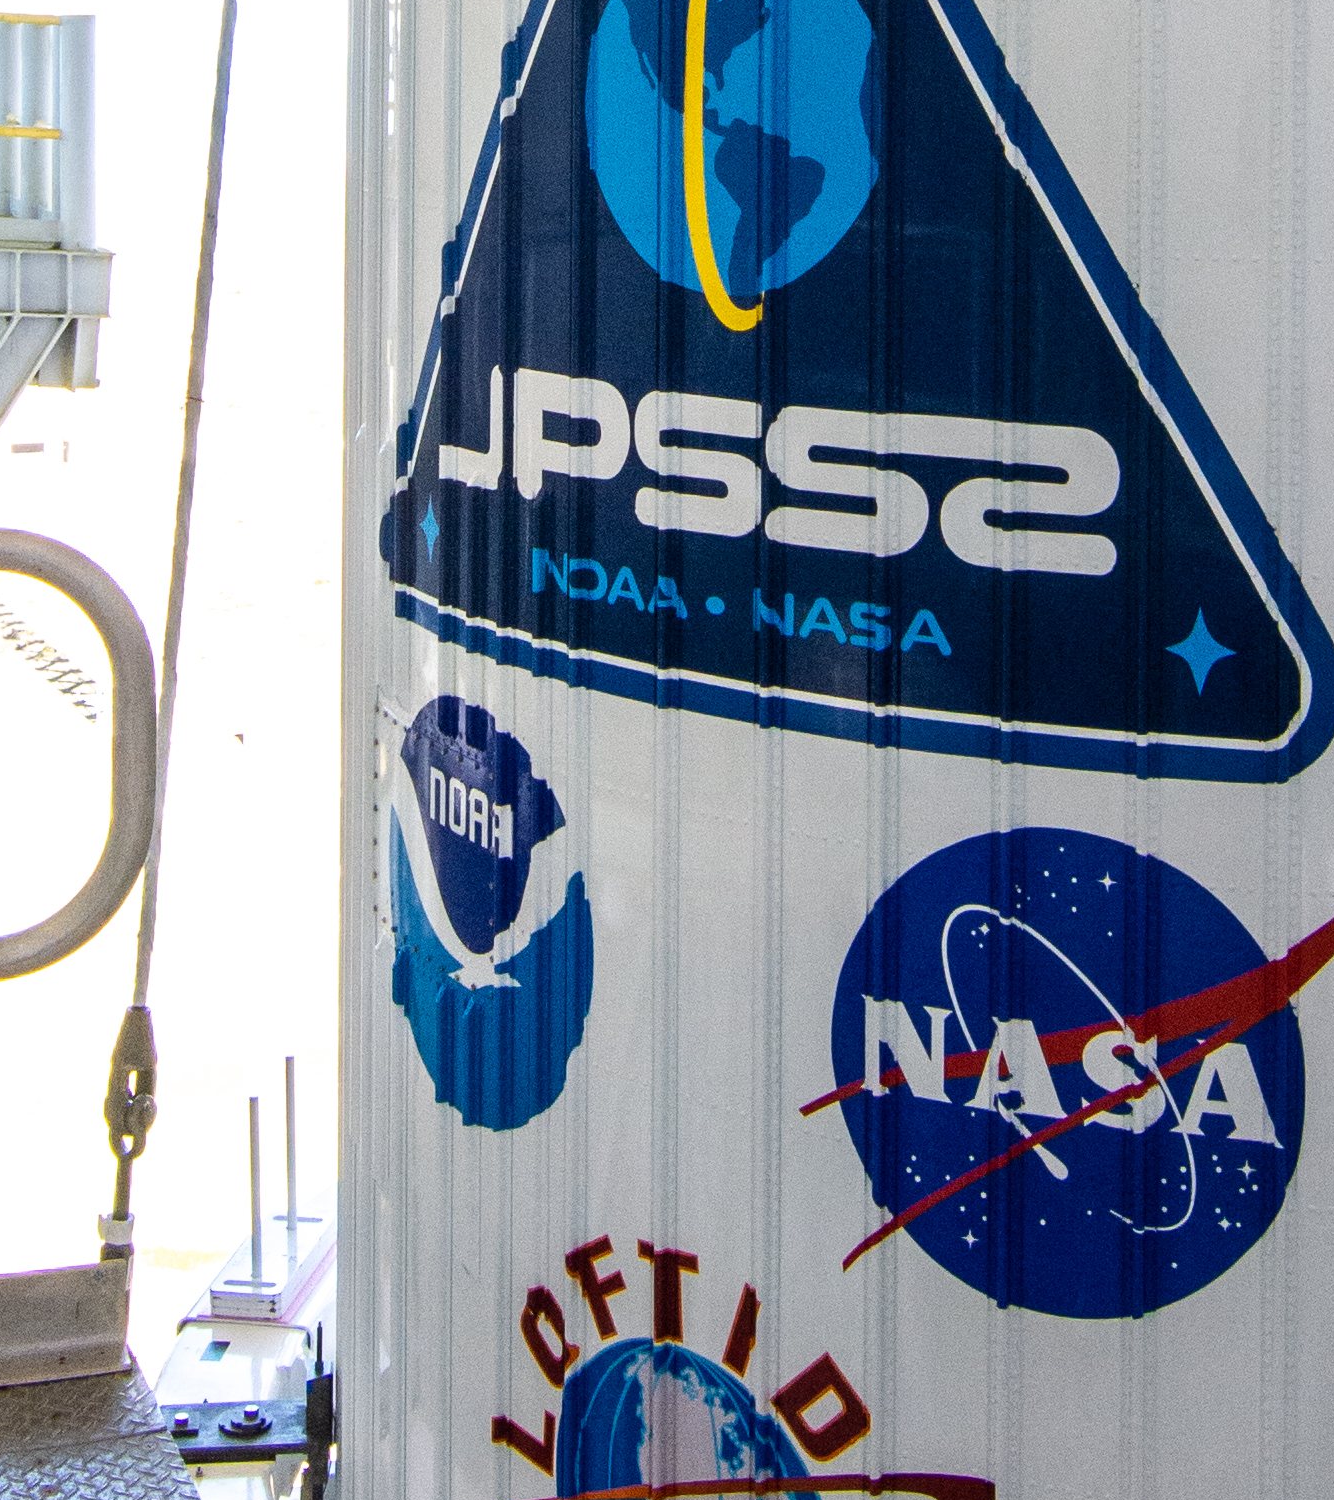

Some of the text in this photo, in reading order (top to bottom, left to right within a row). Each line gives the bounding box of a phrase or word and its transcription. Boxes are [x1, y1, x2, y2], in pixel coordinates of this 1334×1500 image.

[437, 364, 1121, 576] JPSS2
[532, 547, 953, 657] NOAA NASA
[861, 994, 1284, 1149] NASA
[491, 1234, 871, 1477] LOFTID
